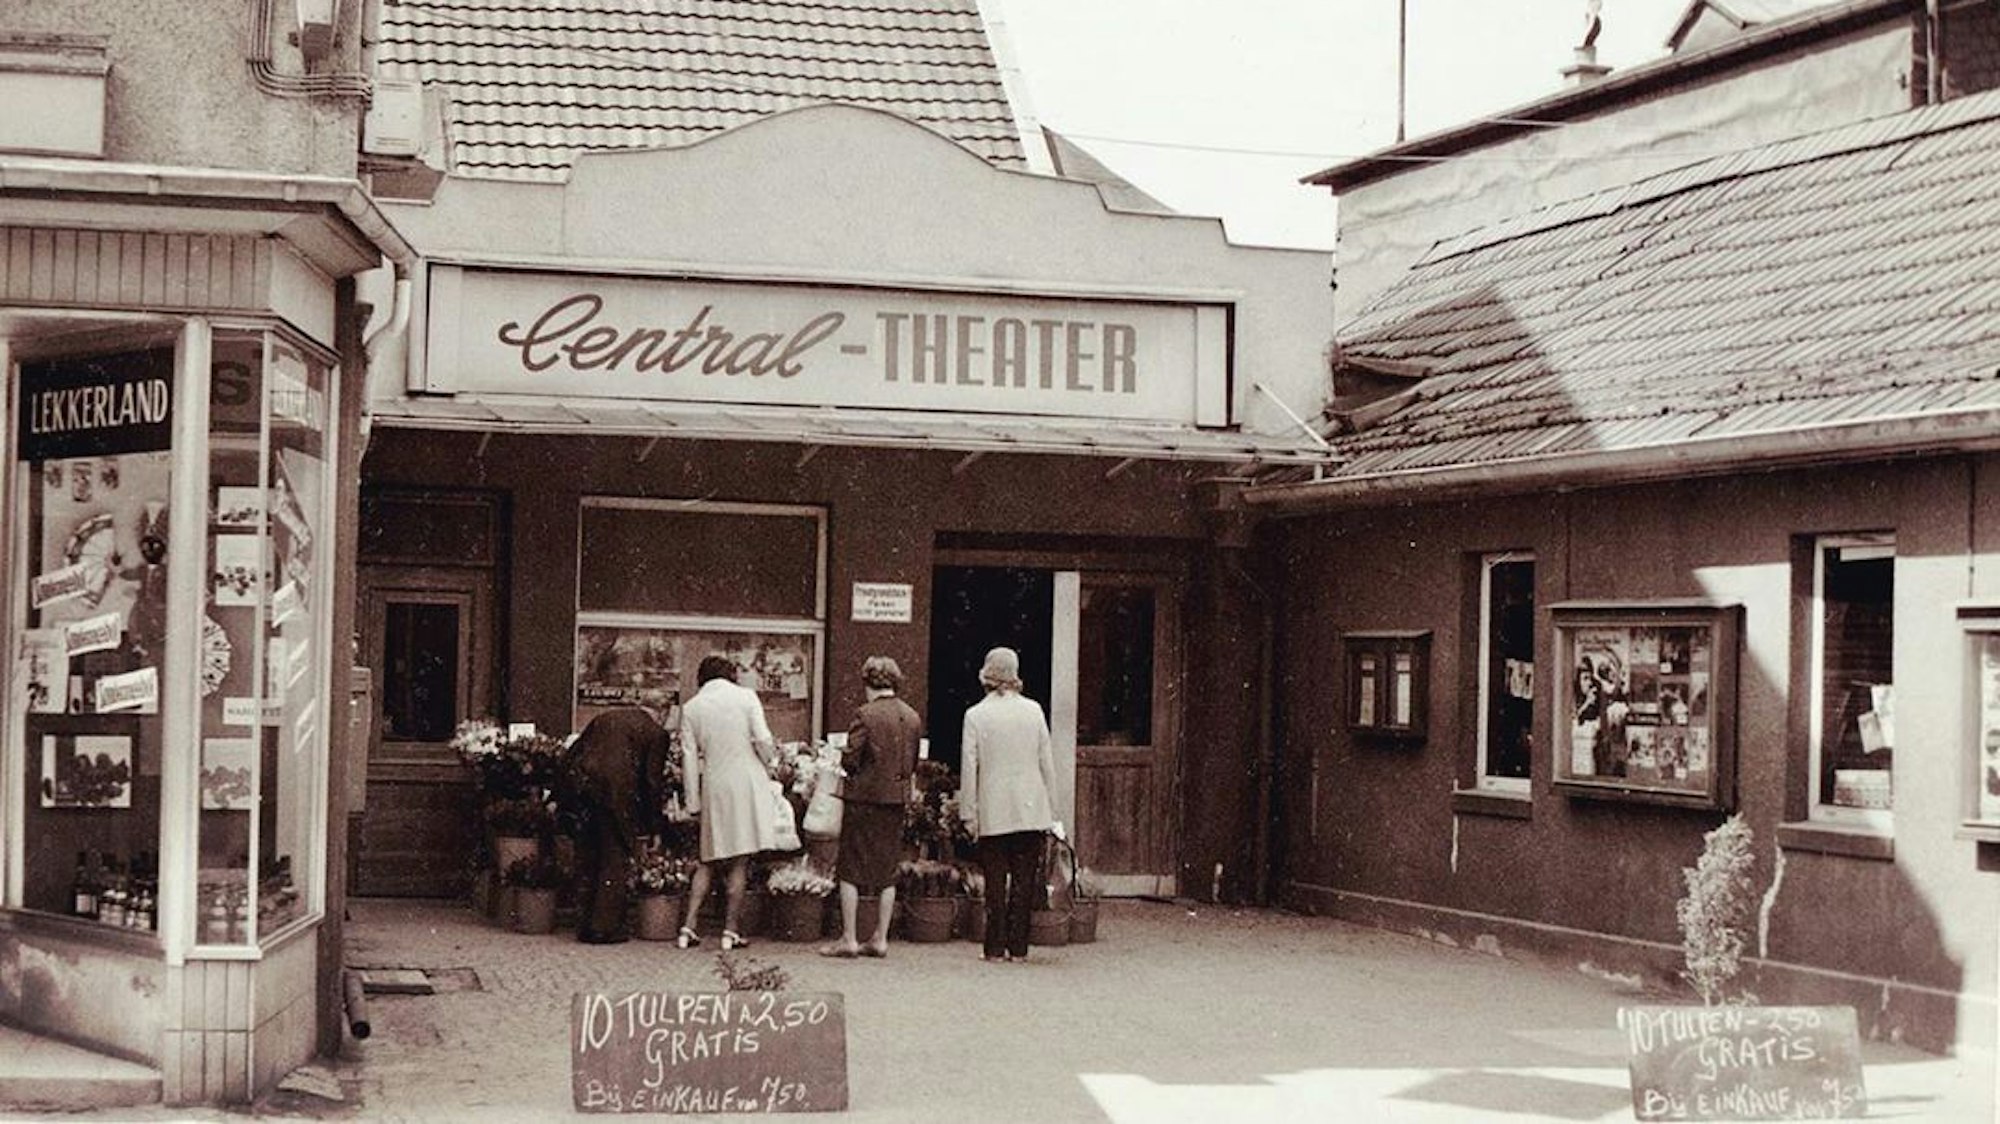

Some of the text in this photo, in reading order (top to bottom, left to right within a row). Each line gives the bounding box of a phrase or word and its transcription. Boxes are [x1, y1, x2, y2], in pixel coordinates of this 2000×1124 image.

[30, 377, 169, 435] LEKKERLAND
[580, 992, 613, 1054] 10
[616, 991, 731, 1039] TULPEN
